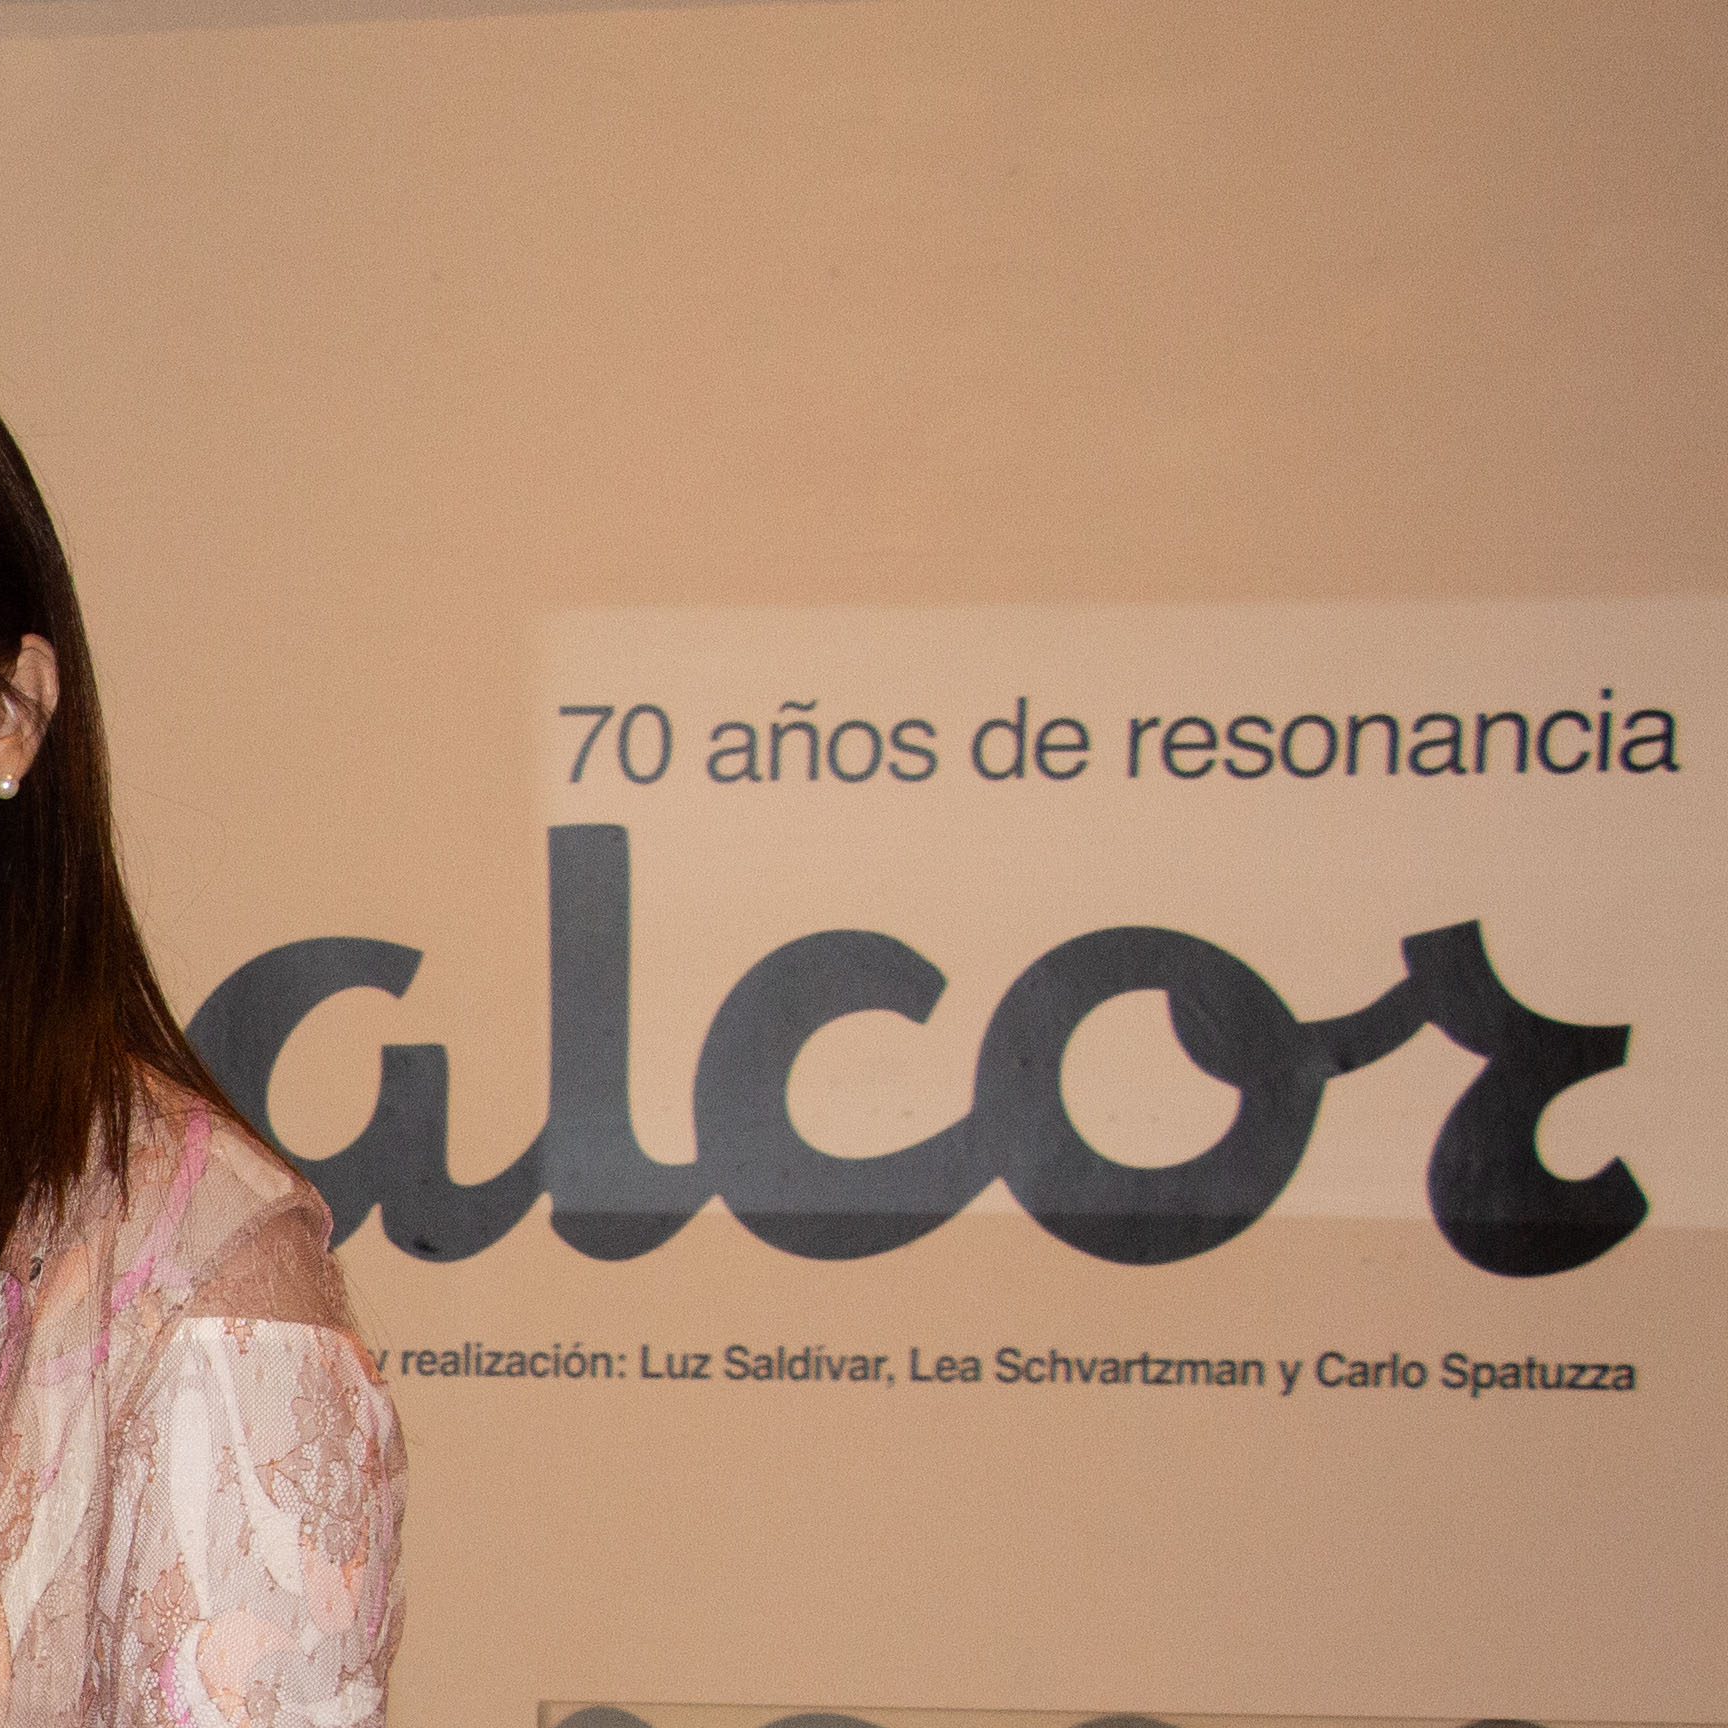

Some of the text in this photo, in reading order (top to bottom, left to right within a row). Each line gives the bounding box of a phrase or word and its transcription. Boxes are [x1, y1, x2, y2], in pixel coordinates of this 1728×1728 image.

[557, 687, 1682, 786] 70 años de resonancia
[184, 822, 1651, 1278] alcor
[400, 1342, 626, 1379] realización:
[639, 1344, 712, 1381] Luz
[722, 1344, 896, 1387] Saldívar,
[908, 1346, 983, 1384] Lea
[993, 1346, 1266, 1388] Schvartzman
[1276, 1359, 1305, 1397] y
[1313, 1350, 1429, 1390] Carlo
[1439, 1351, 1639, 1399] Spatuzza
